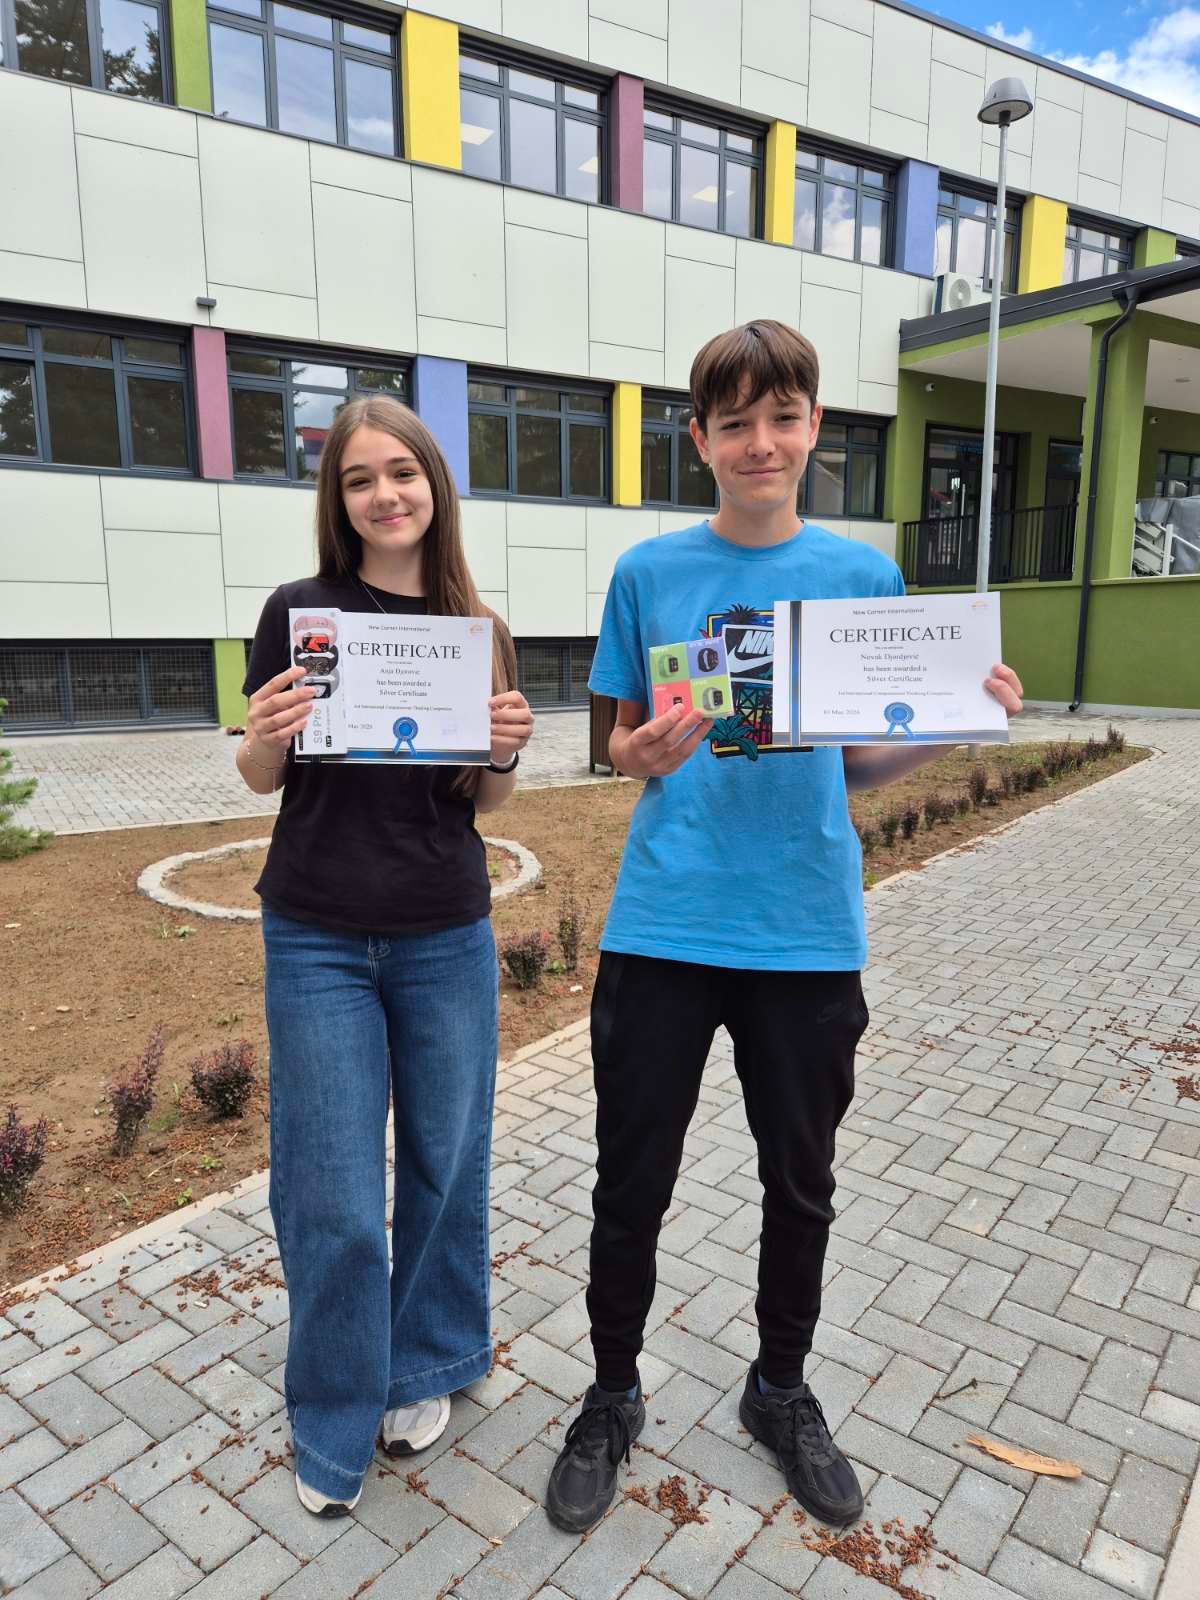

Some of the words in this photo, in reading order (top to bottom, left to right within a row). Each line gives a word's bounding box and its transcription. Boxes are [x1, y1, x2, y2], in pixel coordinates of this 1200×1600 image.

[737, 630, 774, 654] NIK
[830, 625, 962, 643] CERTIFICATE
[347, 642, 462, 660] CERTIFICATE
[312, 708, 322, 726] Pro
[313, 730, 322, 744] S9
